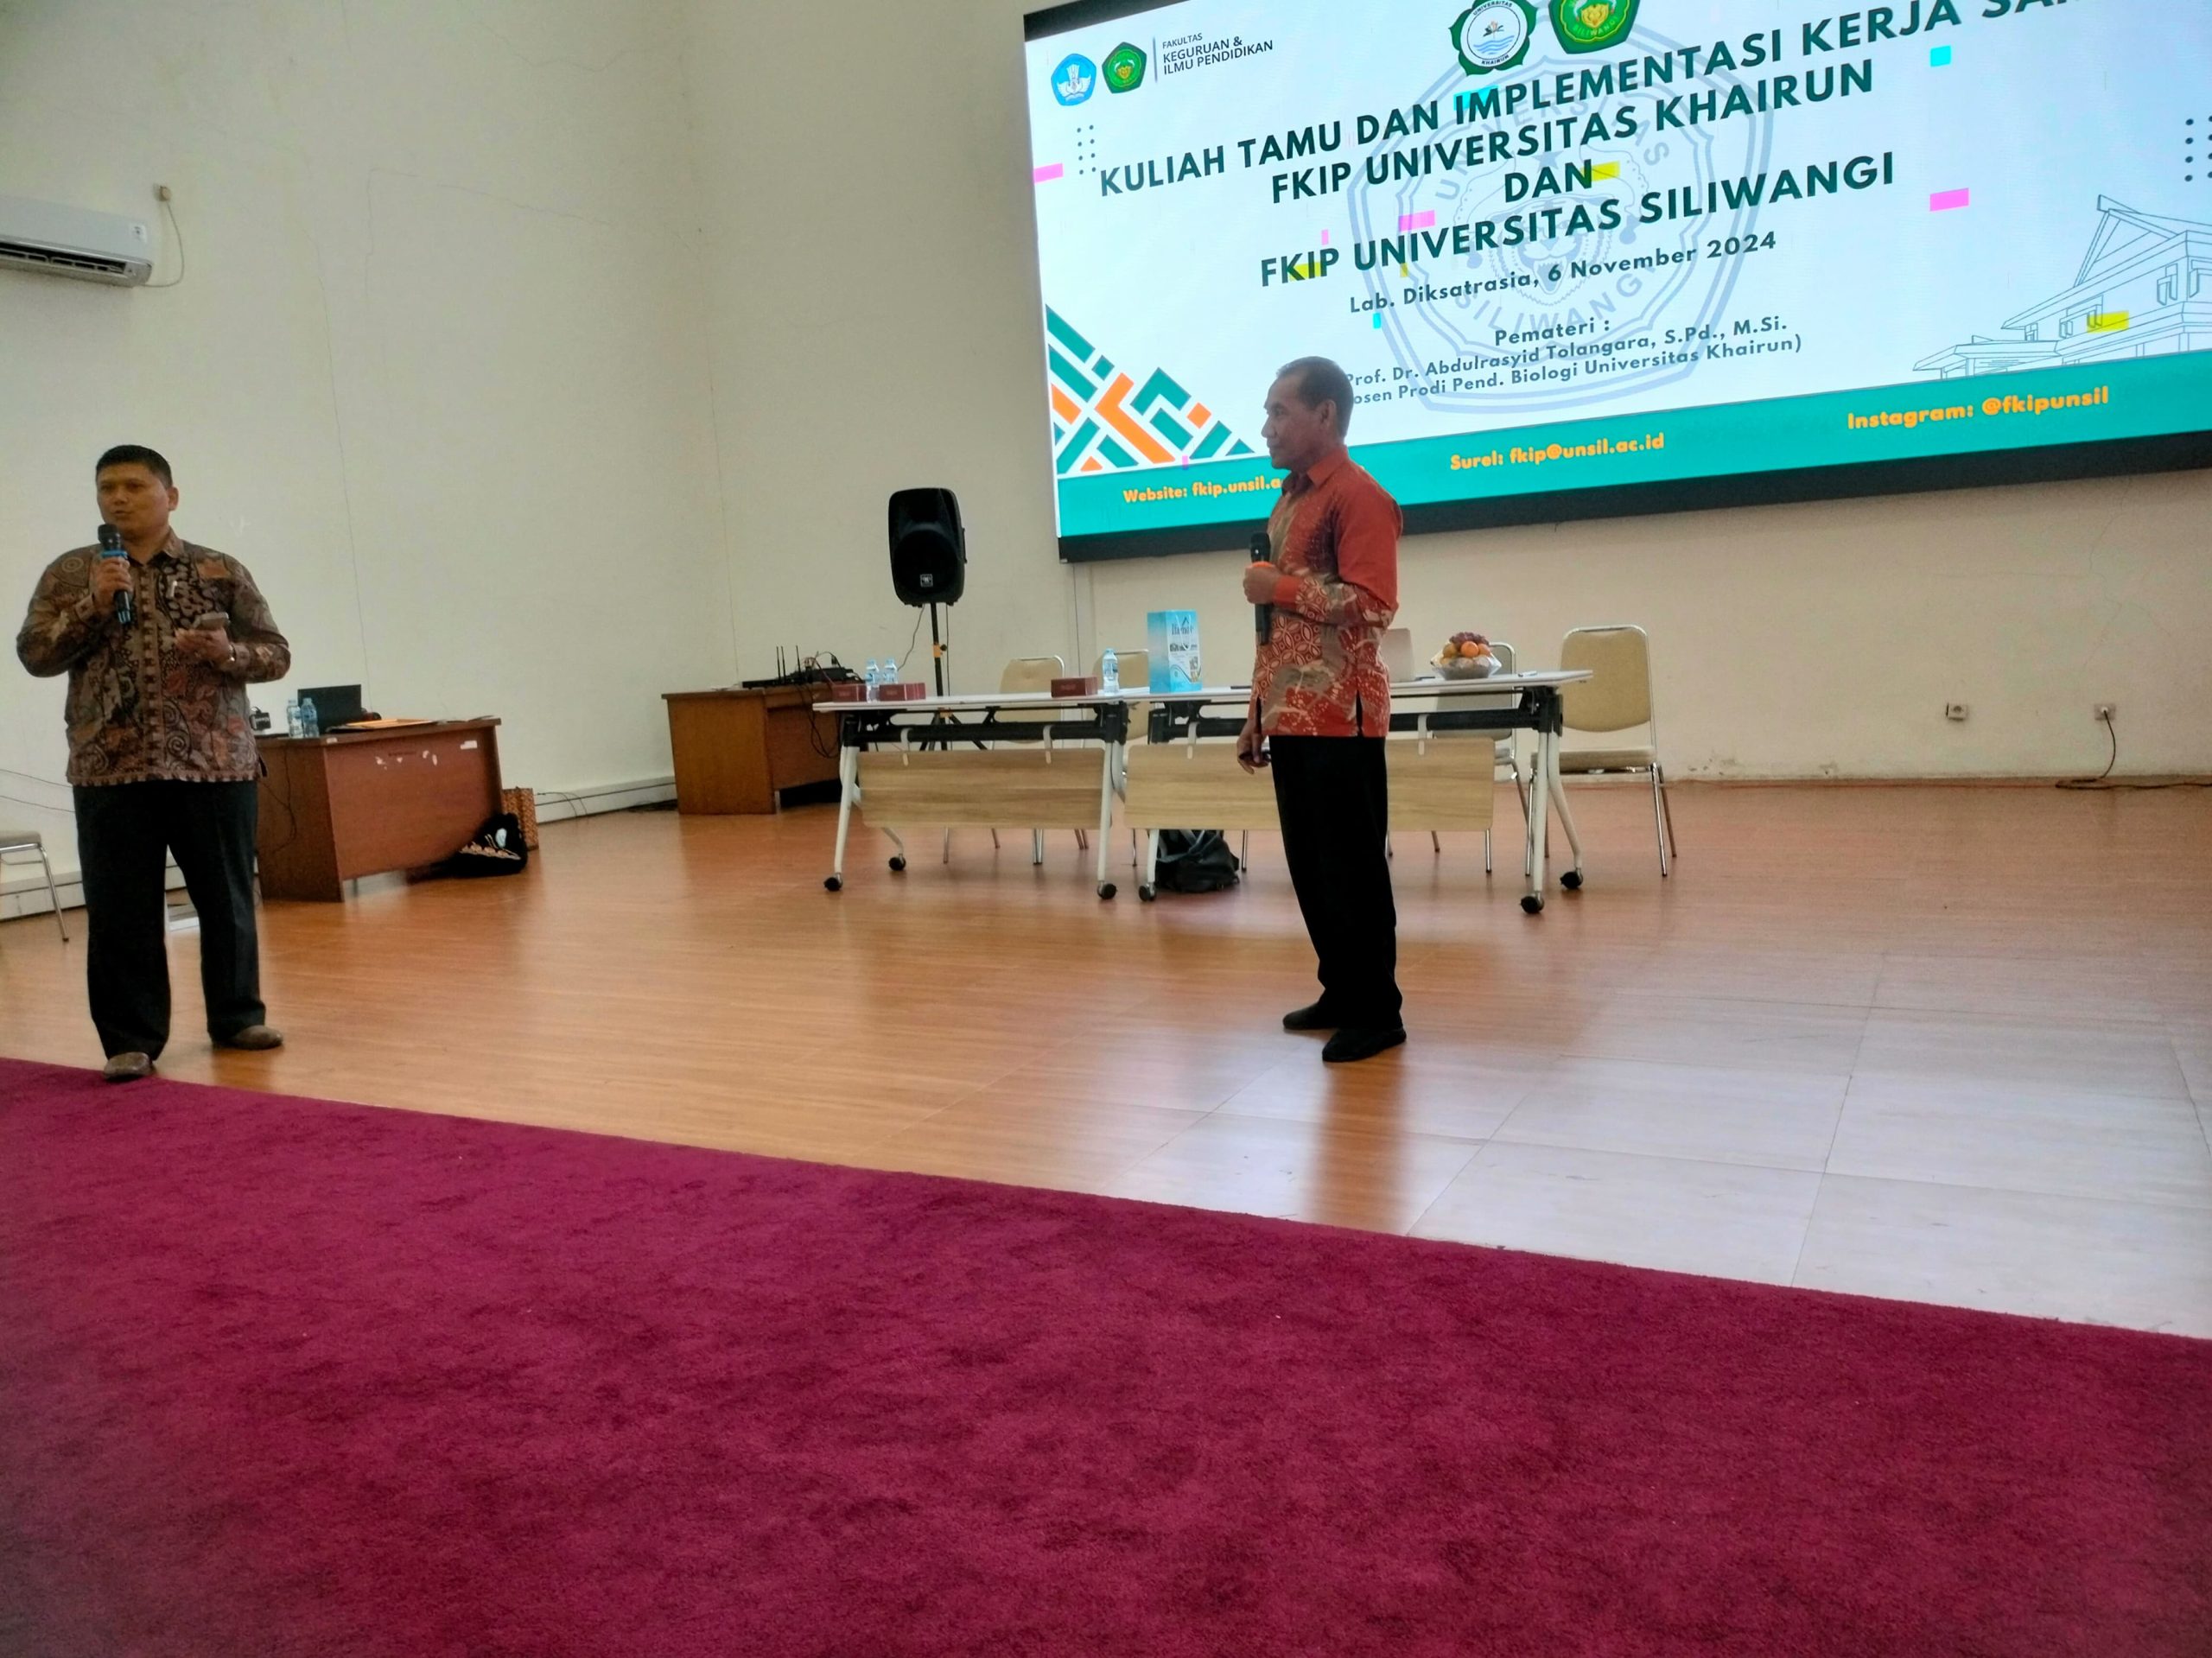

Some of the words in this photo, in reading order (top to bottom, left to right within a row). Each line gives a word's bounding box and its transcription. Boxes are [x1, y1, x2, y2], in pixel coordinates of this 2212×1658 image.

[1162, 33, 1203, 49] FAKULTAS
[1163, 39, 1230, 63] KEGURUAN
[1233, 36, 1243, 47] &
[1164, 60, 1193, 75] ILMU
[1197, 40, 1273, 67] PENDIDIKAN
[1101, 145, 1224, 197] KULIAH
[1237, 121, 1341, 168] TAMU
[1357, 100, 1438, 145] DAN
[1456, 29, 1781, 124] IMPLEMENTASI
[1802, 0, 1961, 56] KERJA
[1272, 162, 1351, 204] FKIP
[1366, 105, 1637, 185] UNIVERSITAS
[1656, 59, 1872, 131] KHAIRUN
[1504, 159, 1592, 203] DAN
[1262, 248, 1339, 287] FKIP
[1354, 199, 1621, 271] UNIVERSITAS
[1639, 151, 1893, 224] SILIWANGI
[1351, 292, 1395, 313] Lab.
[1403, 271, 1539, 305] Diksatrasia,
[1548, 264, 1561, 283] 6
[1571, 248, 1697, 278] November
[1707, 231, 1777, 258] 2024
[1393, 367, 1419, 381] Dr.
[1426, 347, 1540, 377] Abdulrasyid
[1546, 337, 1656, 359] Tolangara,
[1664, 324, 1725, 345] S.Pd.,
[1733, 315, 1787, 336] M.Si.
[1495, 317, 1594, 346] Pemateri
[1353, 391, 1392, 404] osen
[1398, 379, 1446, 398] Prodi
[1452, 372, 1504, 392] Pend.
[1512, 362, 1578, 384] Biologi
[1585, 351, 1699, 374] Universitas
[1707, 334, 1802, 360] Khairun)
[1847, 404, 1974, 429] Instagram:
[1981, 385, 2109, 416] @fkipunsil
[1450, 449, 1503, 470] Surel:
[1510, 432, 1665, 465] fkip@unsil.ac.id
[1123, 486, 1188, 503] Website:
[1192, 475, 1283, 498] fkip.unsil.a
